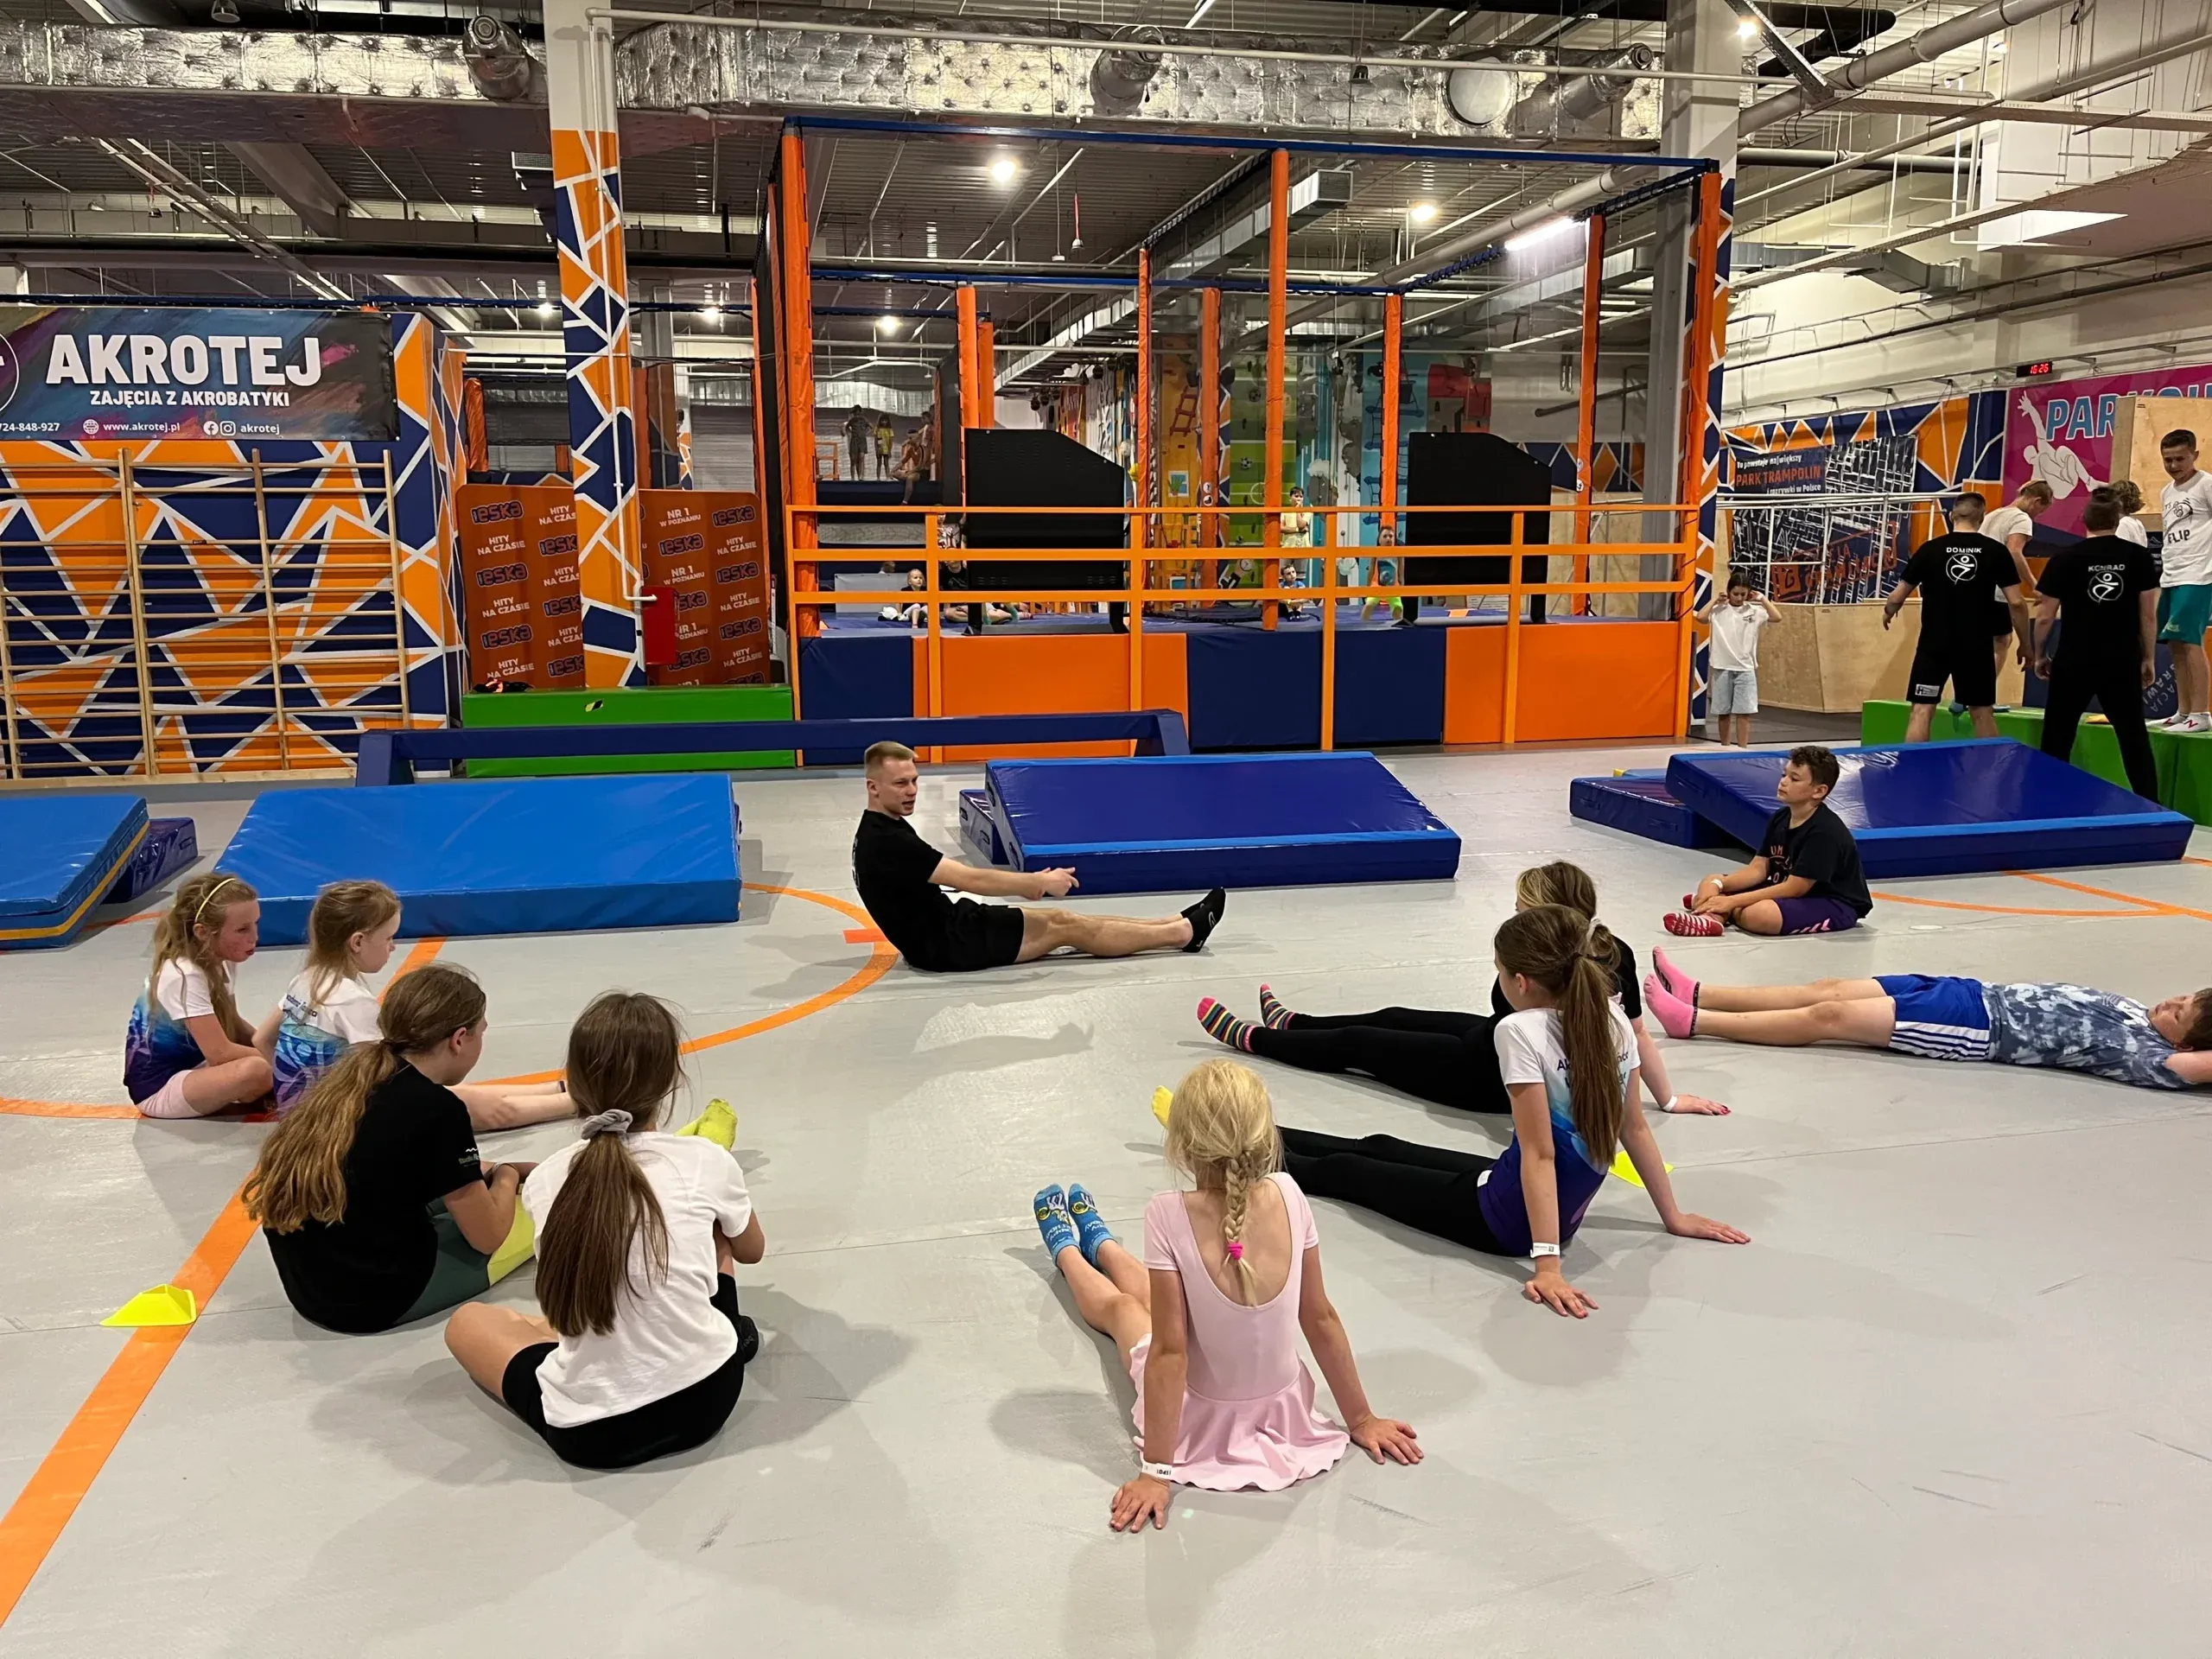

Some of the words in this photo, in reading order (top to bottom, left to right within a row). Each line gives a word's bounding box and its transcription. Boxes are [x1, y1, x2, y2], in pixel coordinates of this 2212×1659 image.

[46, 334, 322, 386] AKROTEJ
[90, 391, 162, 408] ZAJĘCIA
[166, 391, 177, 405] Z
[181, 391, 290, 407] AKROBATYKI
[103, 422, 181, 433] www.akrotej.pl
[240, 423, 280, 435] akrotej
[1736, 472, 1762, 486] PARK
[1764, 466, 1821, 484] TRAMPOLIN
[1802, 483, 1821, 493] Polsce
[550, 505, 570, 515] HITY
[667, 509, 682, 519] NR
[554, 512, 576, 522] CZAS
[668, 514, 702, 525] POZNANIU
[488, 535, 509, 545] HITY
[727, 537, 743, 546] HITY
[2167, 529, 2190, 544] FLIP
[477, 547, 492, 556] NA
[493, 541, 525, 552] CZASIE
[730, 542, 757, 553] CZASIE
[554, 566, 575, 576] HITY
[671, 567, 686, 577] NR
[2088, 563, 2126, 572] KONRAD
[543, 578, 557, 587] NA
[558, 573, 579, 583] CZAS
[672, 572, 705, 583] POZNANIU
[493, 596, 514, 607] HITY
[729, 593, 747, 602] HITY
[734, 597, 760, 609] CZASIE
[482, 609, 497, 618] NA
[498, 602, 531, 614] CZASIE
[558, 626, 579, 636] HITY
[678, 628, 709, 640] OZNANIU
[548, 639, 562, 647] NA
[563, 633, 583, 643] CZA
[733, 647, 750, 658] HITY
[498, 658, 518, 669] HITY
[723, 659, 734, 668] NA
[736, 652, 763, 664] CZASIE
[487, 671, 501, 679] NA
[502, 663, 535, 676] CZASIE
